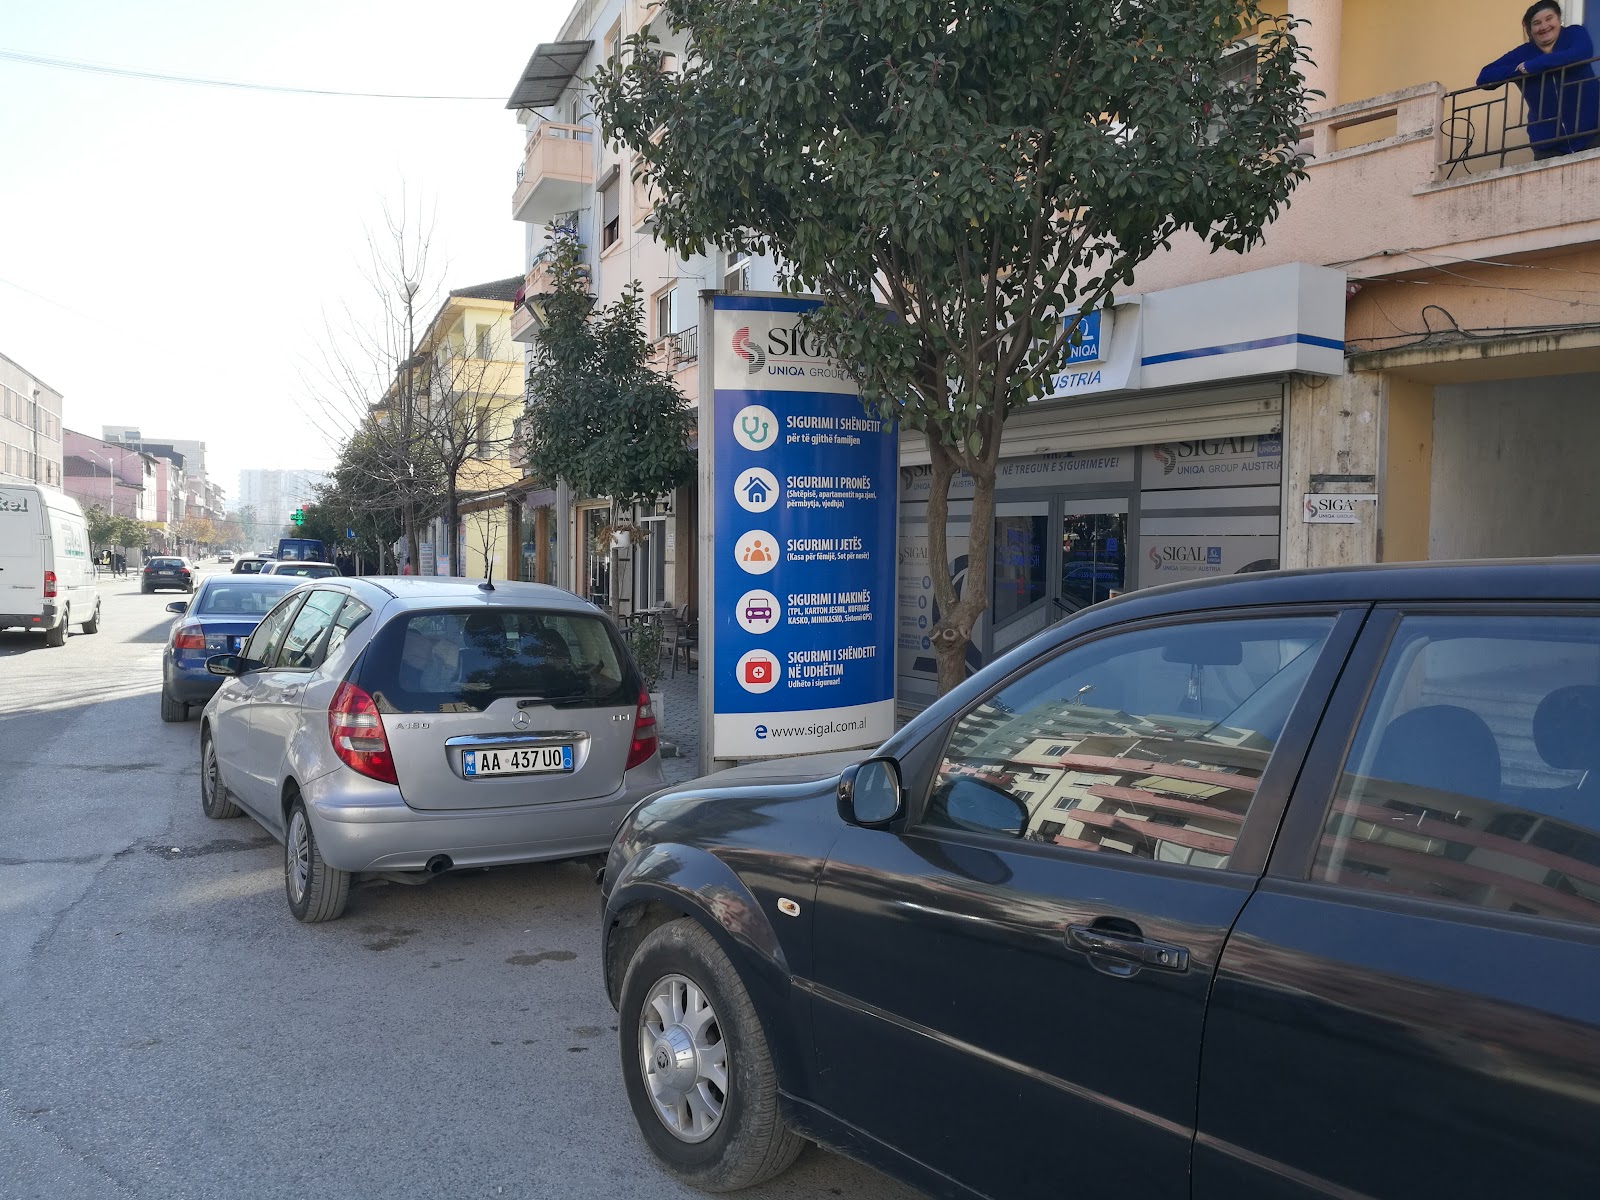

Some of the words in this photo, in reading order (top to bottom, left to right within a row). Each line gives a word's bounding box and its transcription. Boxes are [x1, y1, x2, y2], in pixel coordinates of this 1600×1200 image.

[1067, 344, 1098, 358] NIQA
[768, 366, 805, 376] UNIQA
[1048, 370, 1101, 389] USTRIA
[786, 416, 833, 429] SIGURIMI
[835, 418, 839, 429] I
[840, 416, 881, 432] SHËNDETIT
[786, 433, 800, 444] për
[801, 433, 810, 443] të
[811, 433, 833, 445] gjithë
[833, 434, 861, 446] familjen
[1178, 436, 1255, 458] SIGAL
[1002, 464, 1013, 475] NË
[1015, 463, 1049, 474] TREGUN
[1051, 462, 1057, 472] E
[1058, 457, 1120, 471] SIGURIMEVE!
[1177, 465, 1205, 475] UNIQA
[1208, 464, 1238, 473] GROUP
[786, 476, 833, 489] SIGURIMI
[835, 477, 839, 489] I
[840, 475, 871, 490] PRONËS
[1319, 499, 1357, 511] SIGA
[786, 538, 833, 551] SIGURIMI
[835, 539, 839, 550] I
[840, 536, 862, 551] JETËS
[786, 552, 805, 561] (Kasa
[805, 552, 816, 562] për
[1163, 546, 1206, 561] SIGAL
[787, 593, 831, 606] SIGURIMI
[833, 592, 837, 604] I
[838, 589, 871, 604] MAKINËS
[787, 607, 804, 616] (TPL,
[804, 606, 828, 614] KARTON
[787, 616, 810, 625] KASKO,
[810, 615, 844, 624] MINIKASKO,
[787, 650, 832, 663] SIGURIMI
[833, 649, 837, 661] I
[837, 645, 876, 660] SHËNDETIT
[788, 664, 801, 678] NË
[803, 662, 844, 678] UDHËTIM
[788, 680, 811, 688] Udhëto
[771, 717, 867, 738] www.sigal.com.al
[481, 752, 501, 771] AA
[511, 750, 539, 769] 437
